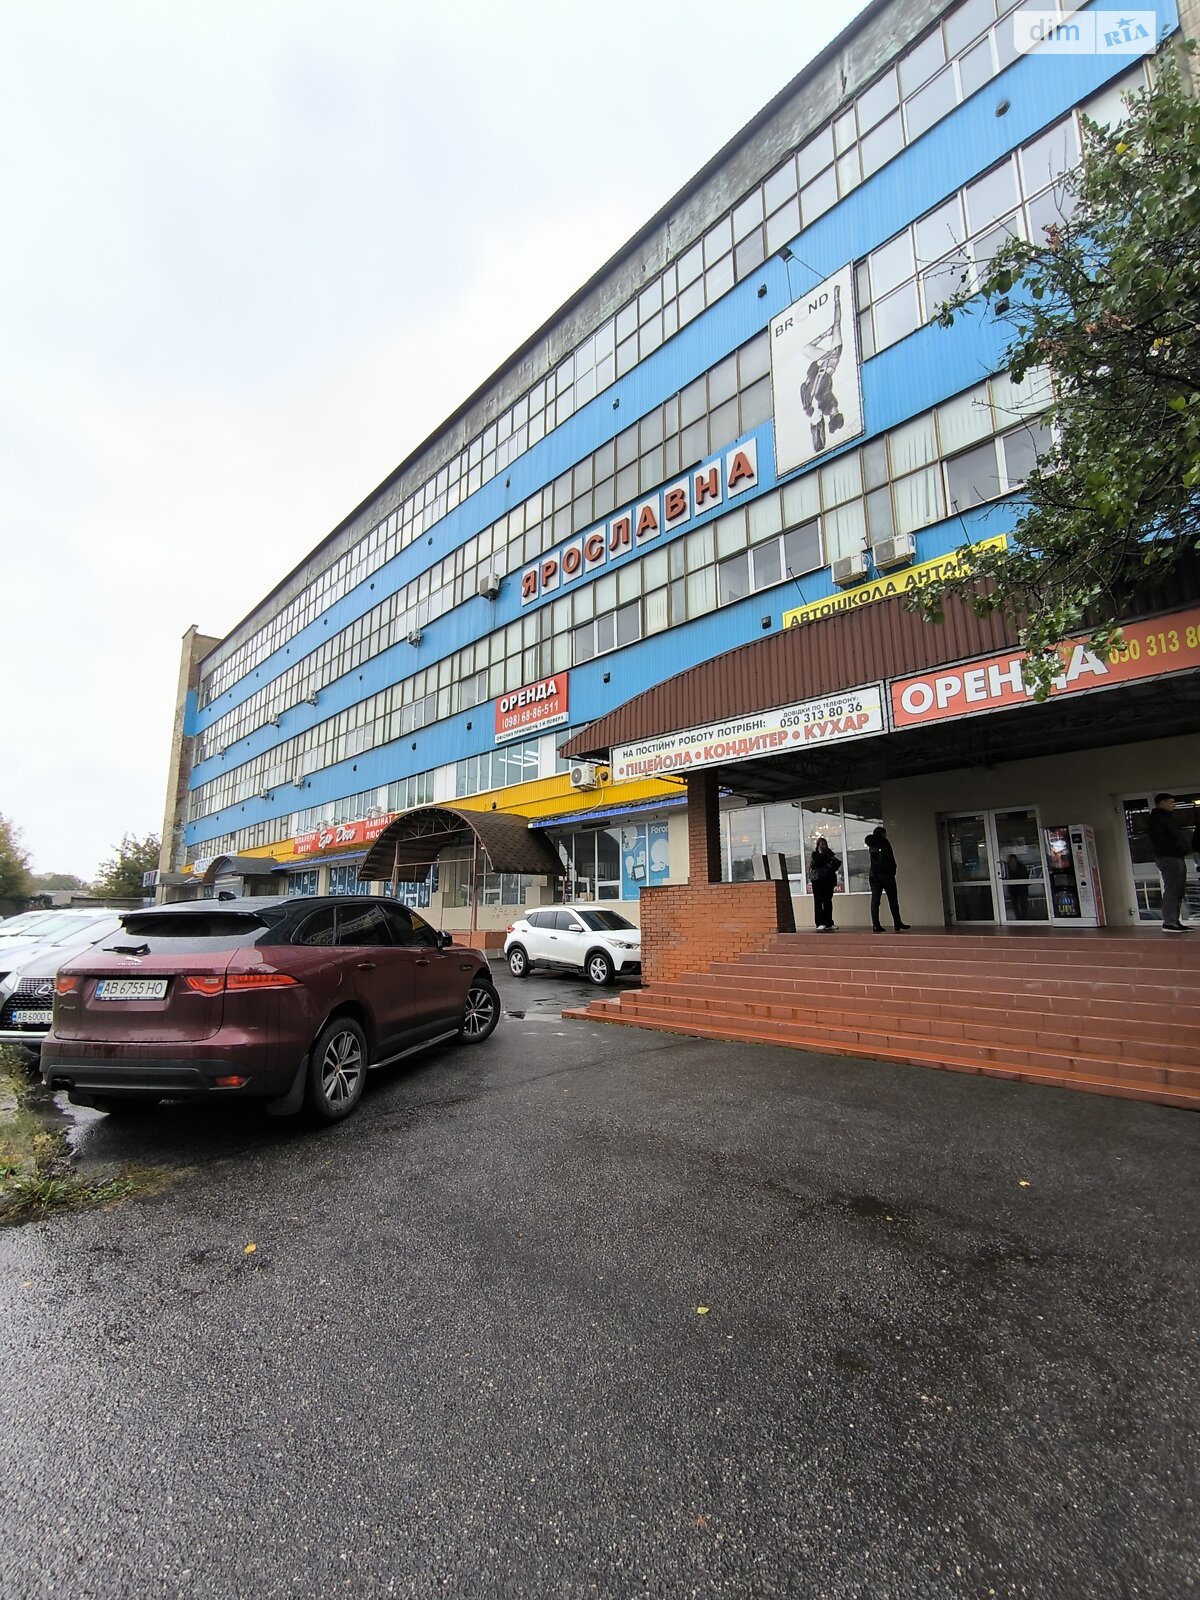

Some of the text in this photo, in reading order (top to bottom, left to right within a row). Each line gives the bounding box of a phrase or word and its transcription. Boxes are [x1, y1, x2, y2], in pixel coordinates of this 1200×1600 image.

[521, 451, 755, 598] ЯРОСЛАВНА
[790, 581, 898, 628] АВТОШКОЛА
[1145, 630, 1181, 657] 313
[500, 679, 558, 713] ОРЕНДА
[502, 713, 520, 730] (098)
[780, 701, 863, 728] 050 313 80 36
[783, 707, 811, 718] ДОВІДКИ
[622, 719, 766, 759] НА ПОСТІЙНУ РОБОТУ ПОТРІБНІ:
[625, 712, 870, 777] ПІЦЕЙОЛА КОНДИТЕР КУХАР
[103, 982, 163, 995] AB 6755 HO
